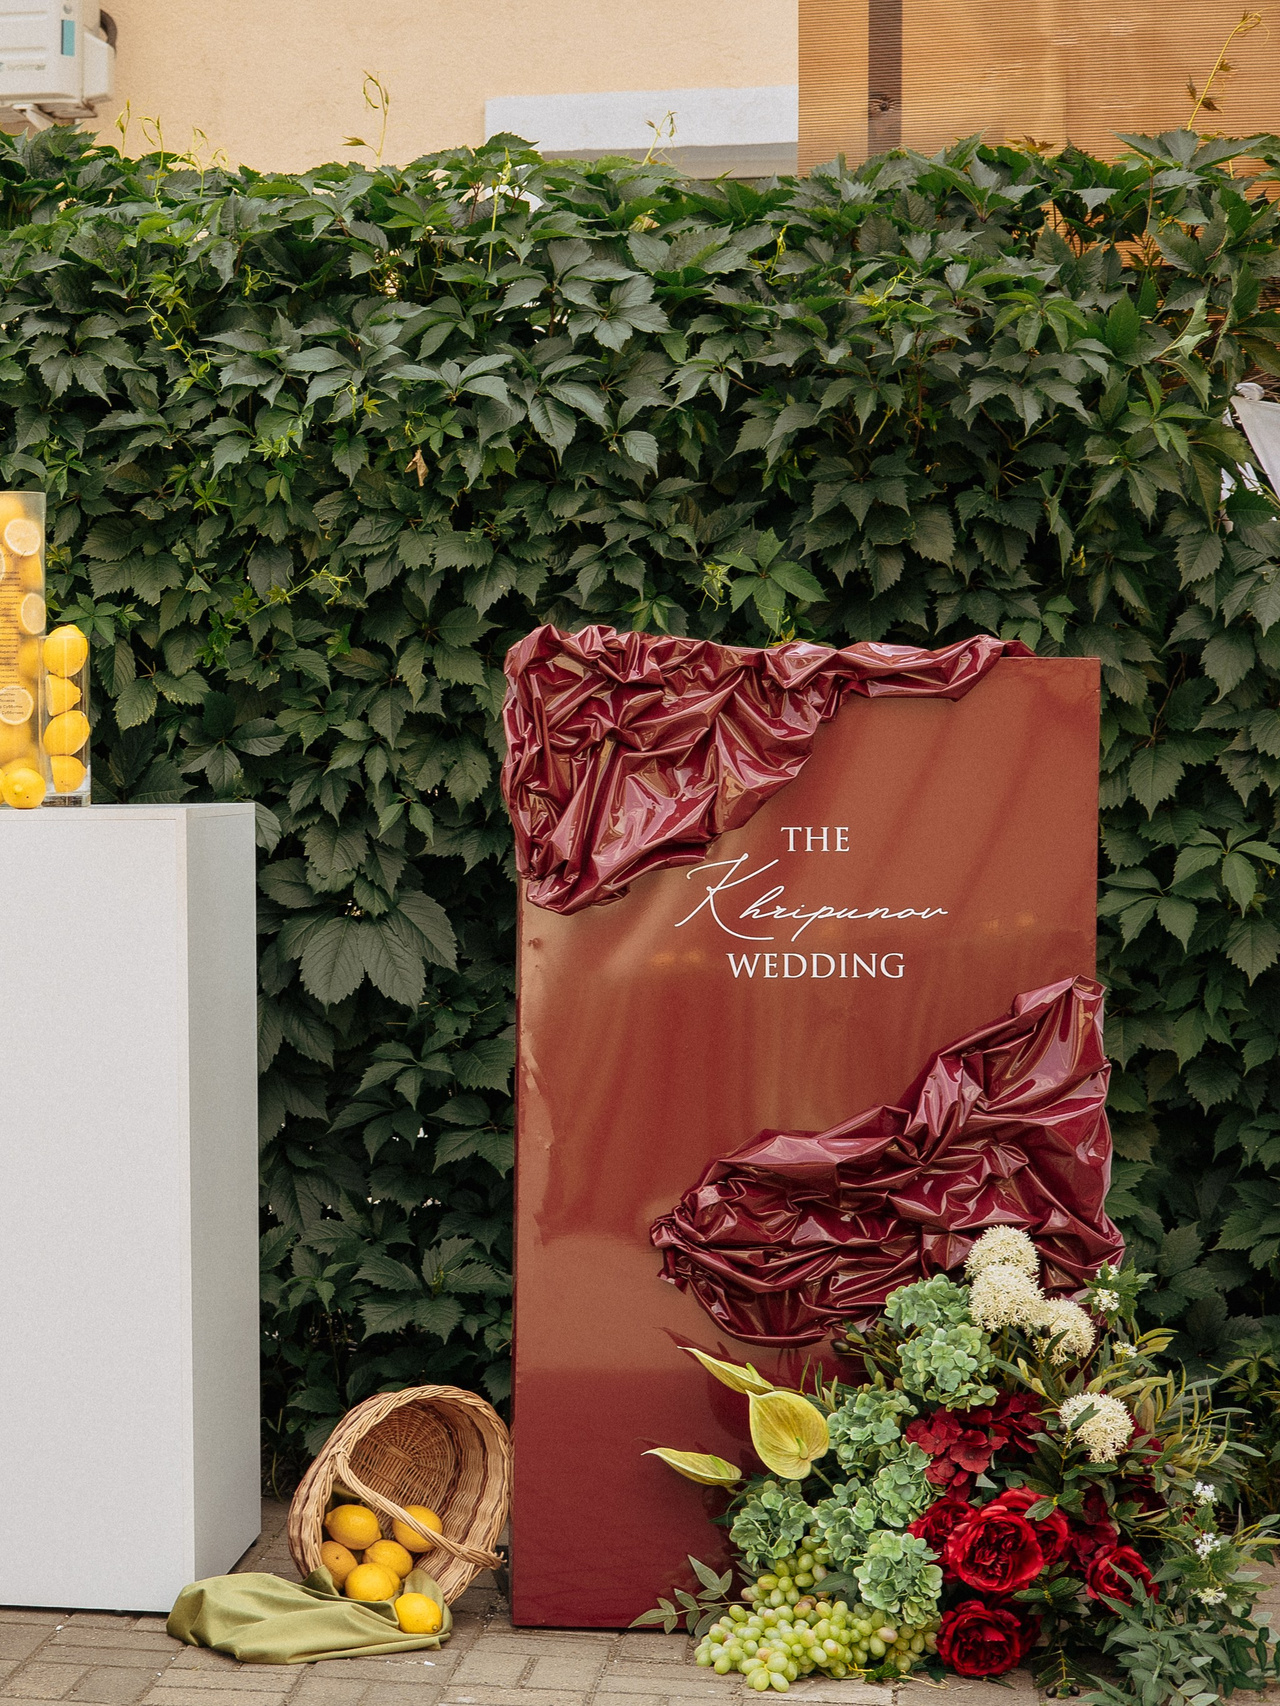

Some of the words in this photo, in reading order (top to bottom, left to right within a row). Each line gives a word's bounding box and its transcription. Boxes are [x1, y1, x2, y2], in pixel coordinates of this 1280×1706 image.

[780, 826, 850, 852] THE
[674, 852, 949, 942] Khripunov
[726, 953, 906, 979] WEDDING
